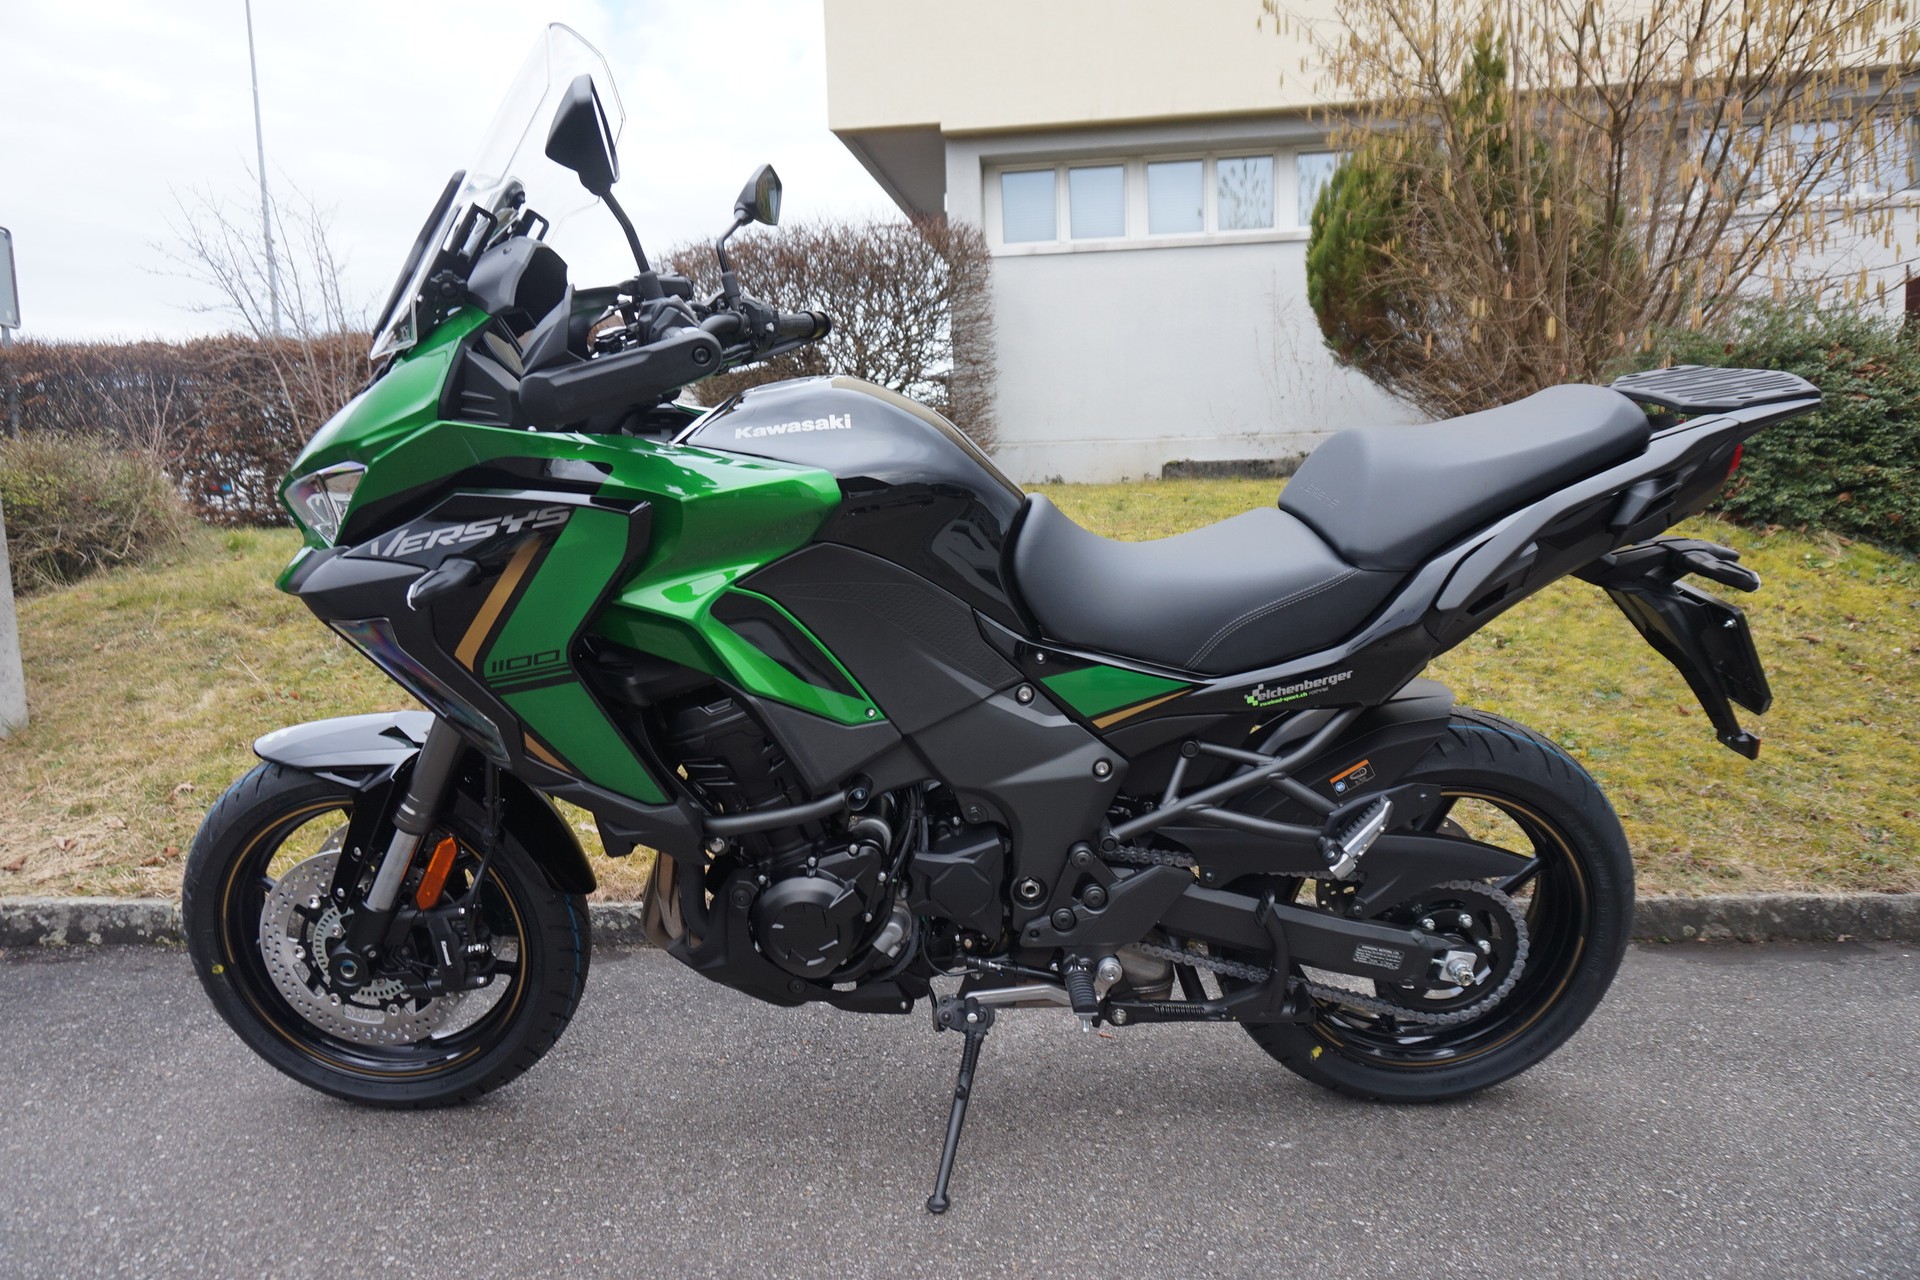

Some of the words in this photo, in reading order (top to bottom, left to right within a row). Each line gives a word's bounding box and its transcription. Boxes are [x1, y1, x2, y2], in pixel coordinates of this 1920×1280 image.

[735, 413, 852, 439] Kawasaki
[370, 505, 572, 557] VERSYS
[492, 650, 560, 673] 1100
